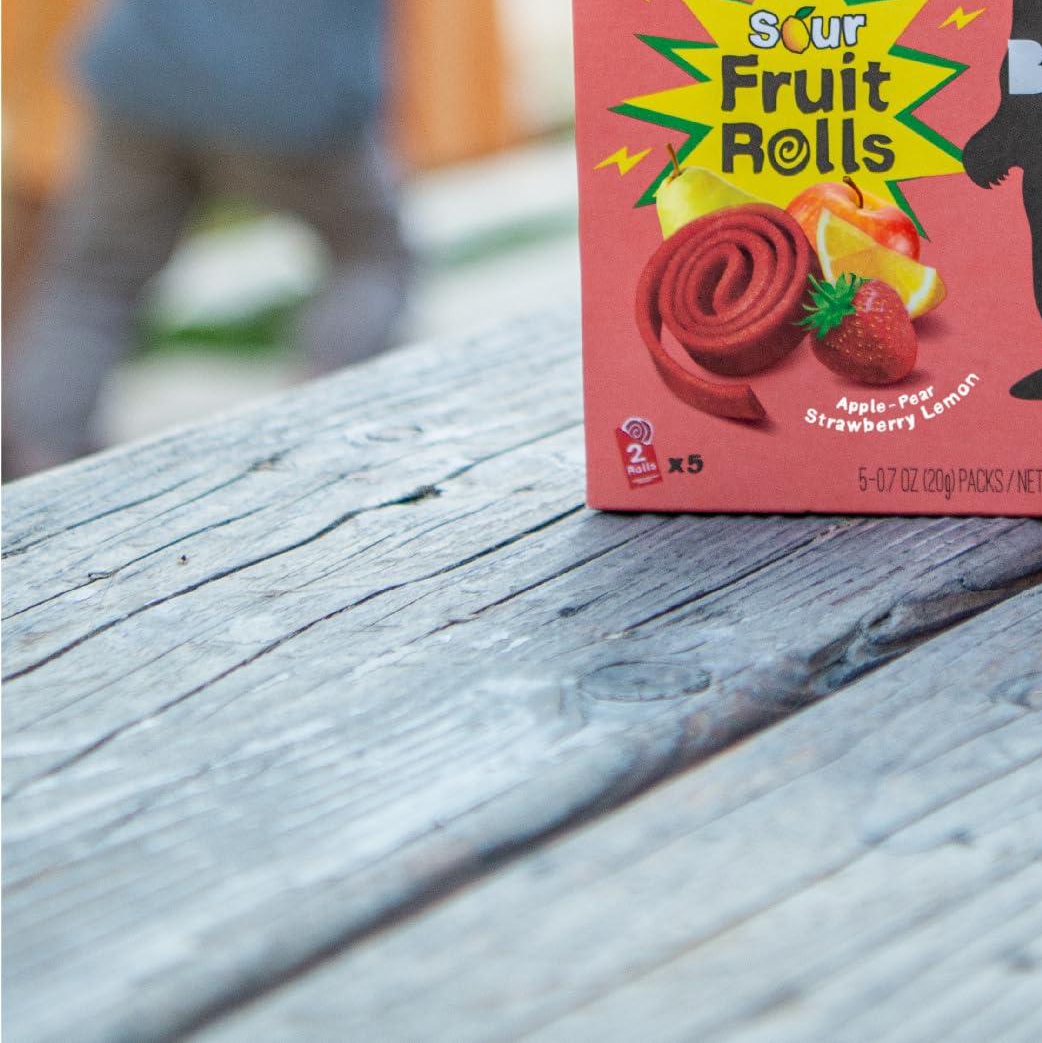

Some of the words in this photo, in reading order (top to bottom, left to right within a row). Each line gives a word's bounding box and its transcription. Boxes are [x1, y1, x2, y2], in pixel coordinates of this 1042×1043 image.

[720, 51, 891, 115] Fruit
[720, 117, 896, 176] Rolls
[804, 408, 916, 433] Strawberry
[920, 372, 980, 420] Lemon
[626, 443, 646, 465] 2
[626, 462, 657, 476] Rolls
[901, 468, 919, 493] OZ
[923, 468, 956, 500] (20g)
[959, 468, 1003, 493] PACKS
[1017, 469, 1042, 494] NET
